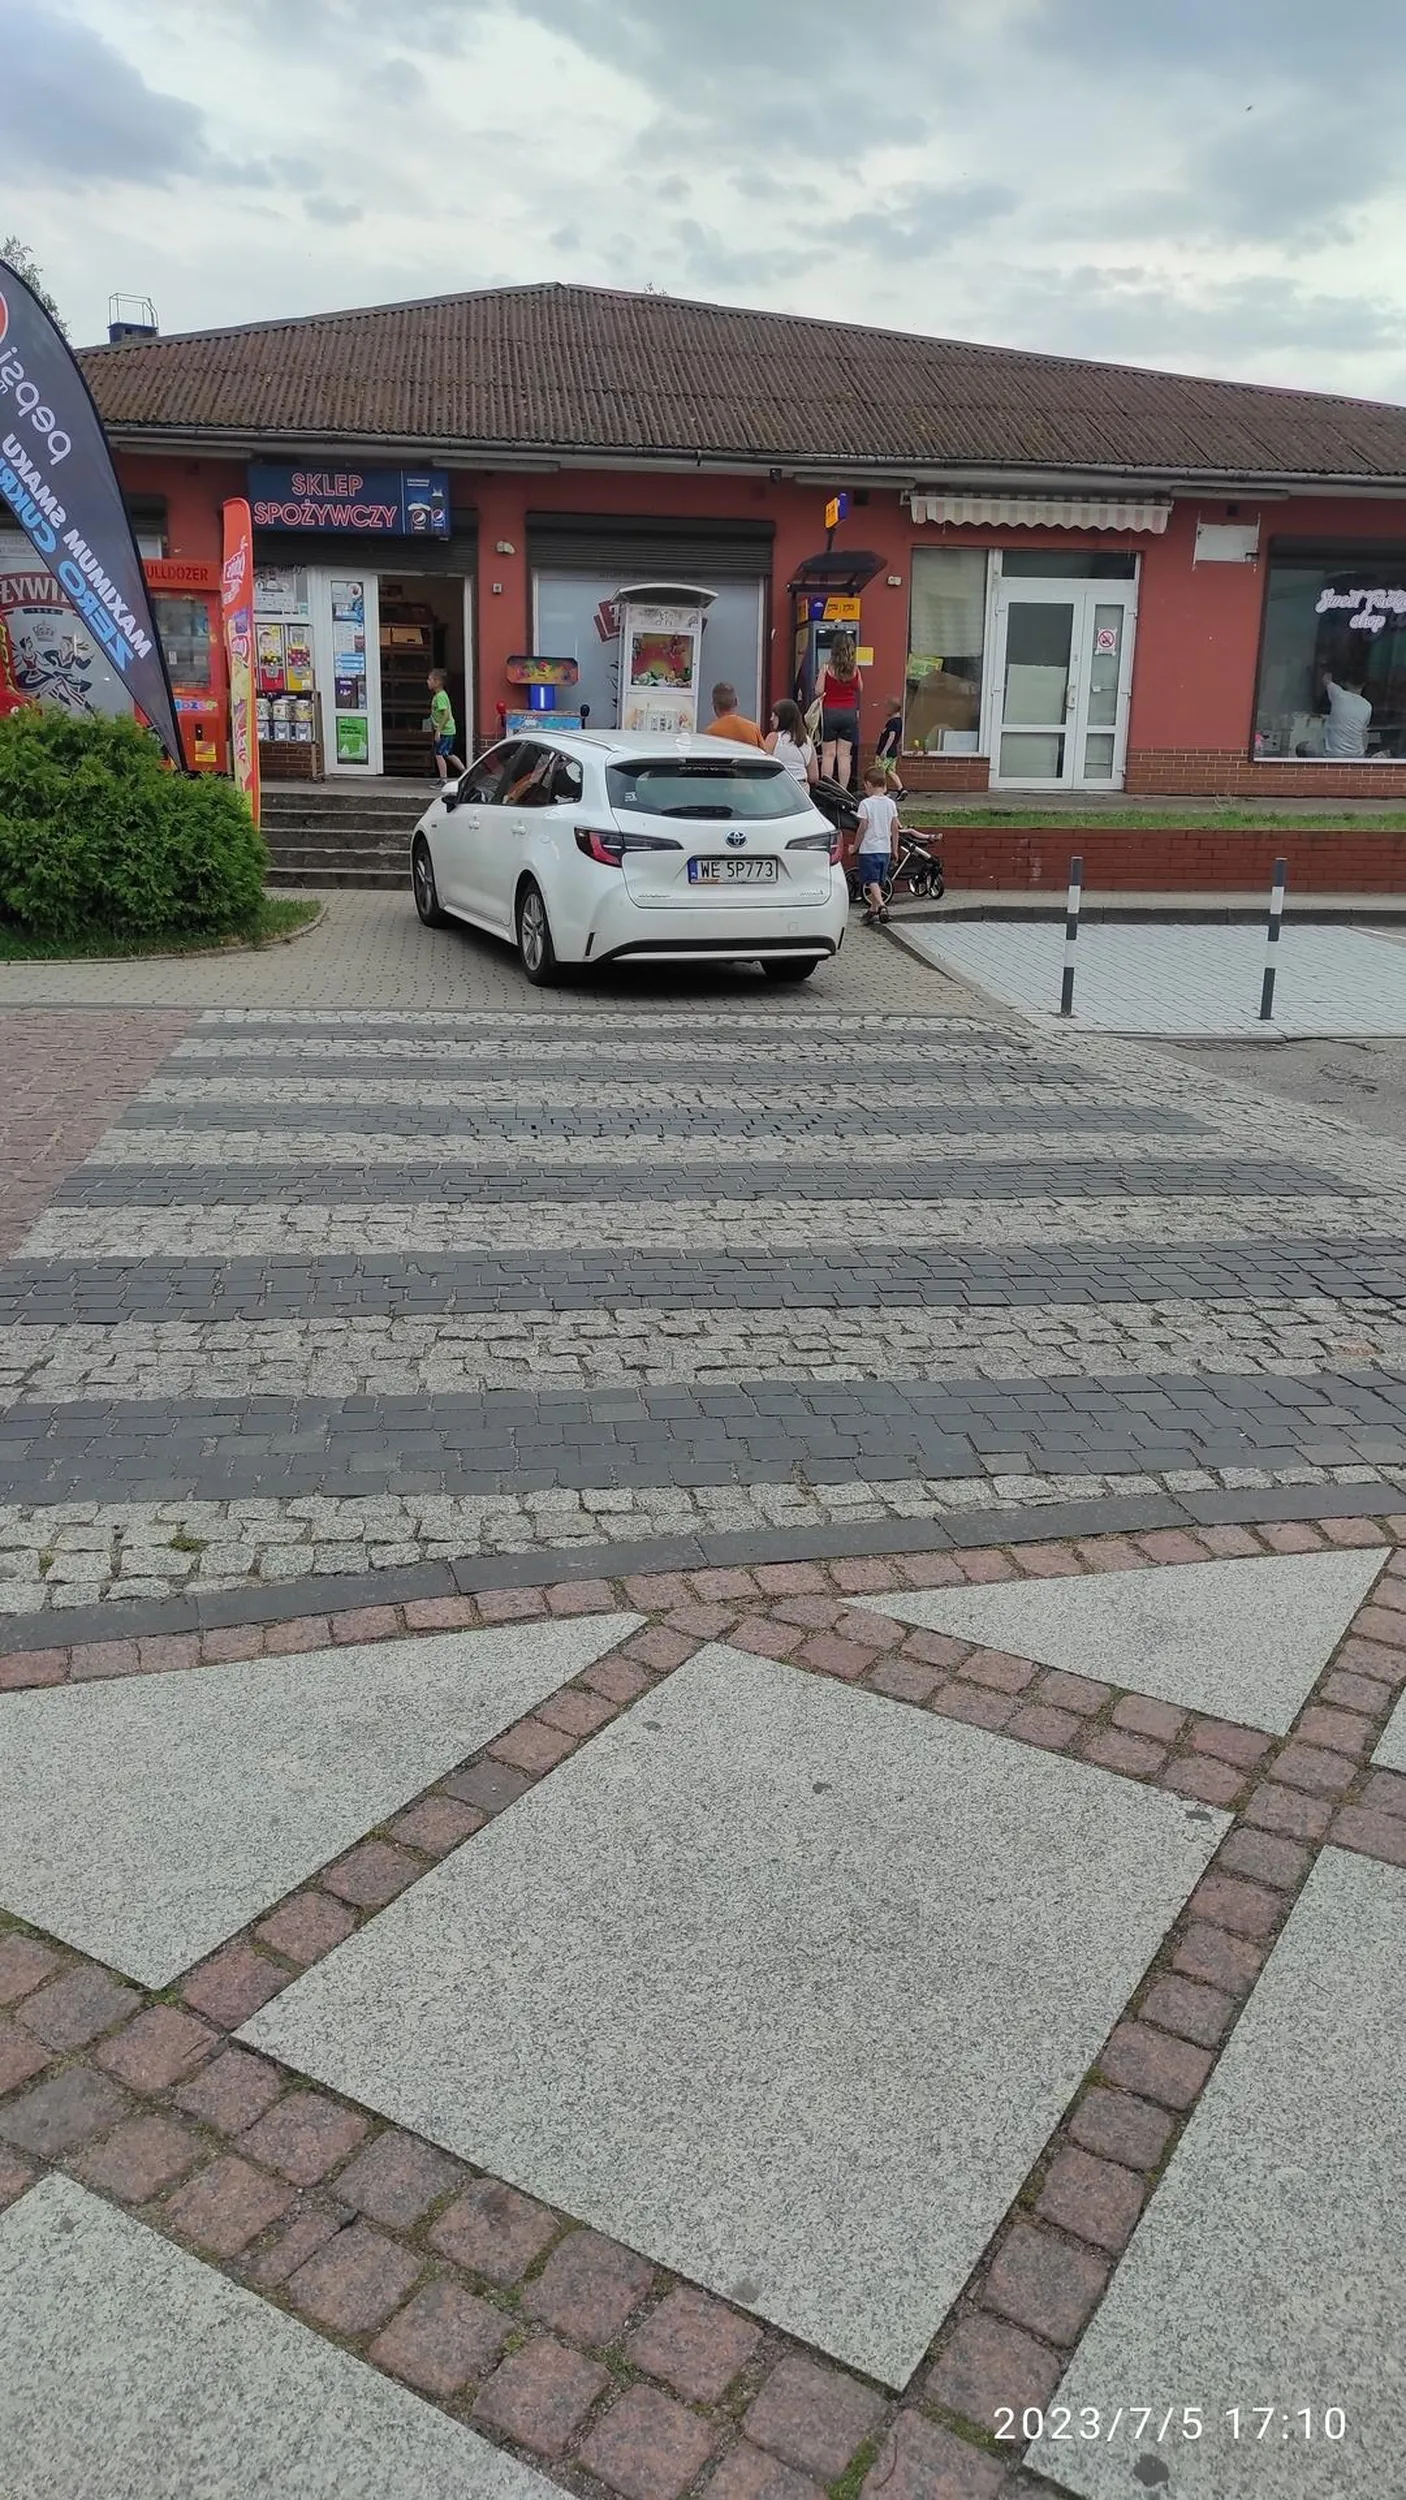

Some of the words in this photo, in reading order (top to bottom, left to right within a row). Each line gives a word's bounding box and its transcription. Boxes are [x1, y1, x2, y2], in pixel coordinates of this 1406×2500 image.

[291, 473, 363, 497] SKLEP
[254, 499, 398, 528] SPOŻYWCZY
[146, 564, 208, 581] ULLDOZER
[701, 862, 720, 878] WE
[727, 862, 773, 878] 5P773
